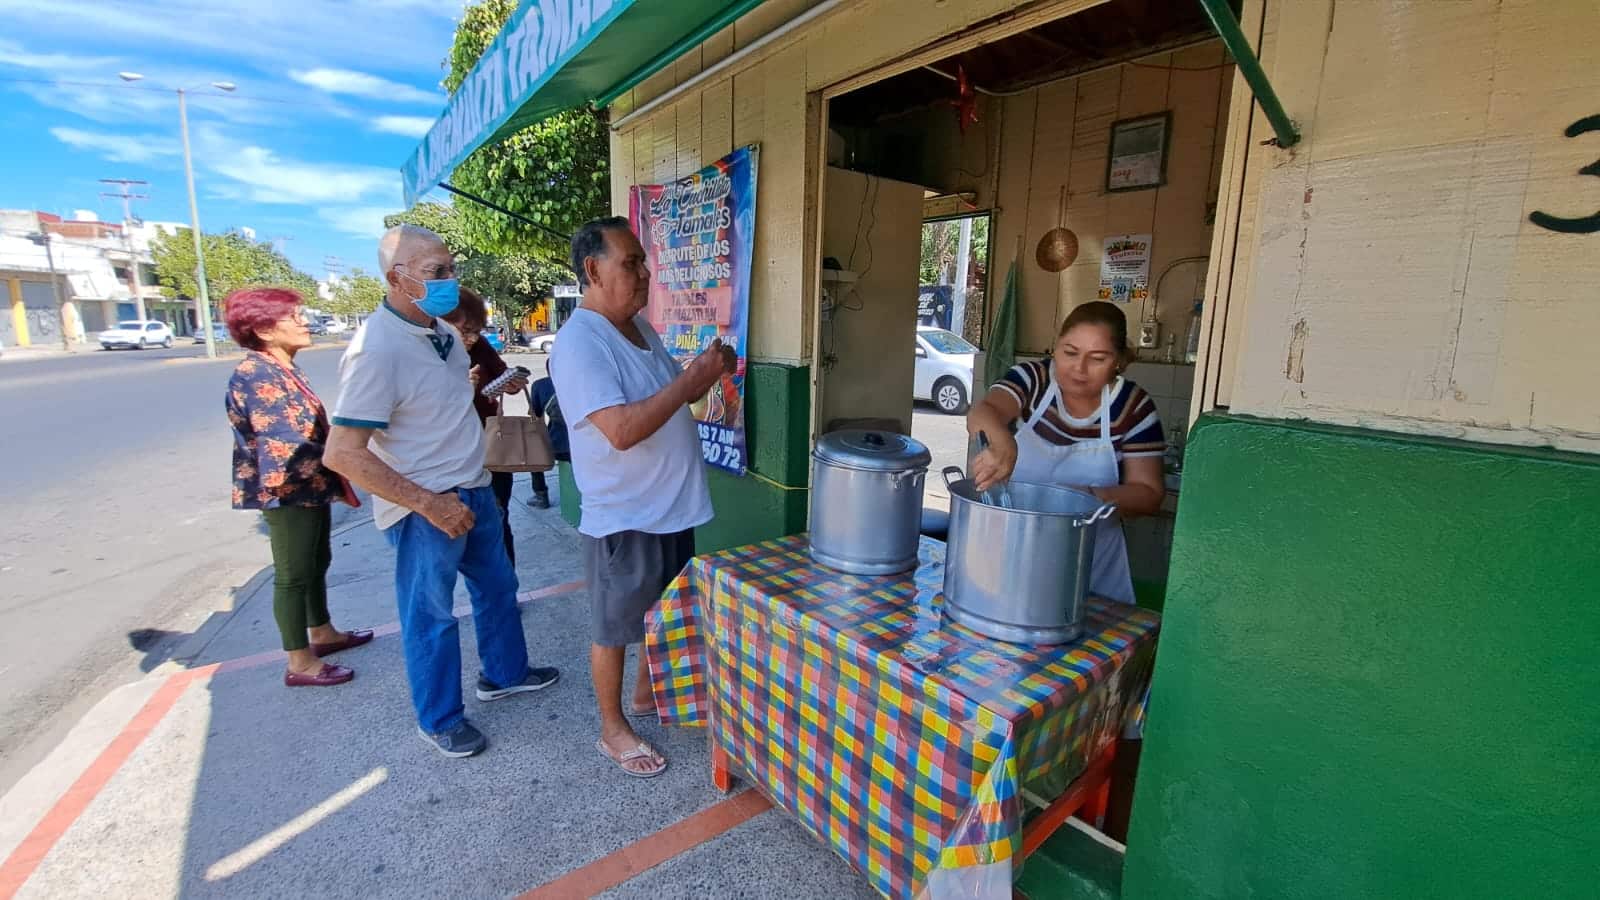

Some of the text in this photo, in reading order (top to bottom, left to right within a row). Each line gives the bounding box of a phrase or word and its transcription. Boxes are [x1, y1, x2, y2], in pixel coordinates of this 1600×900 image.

[506, 0, 615, 102] TAM
[709, 239, 730, 257] LOS
[675, 262, 731, 281] DELICIOSOS
[1112, 285, 1127, 295] 30
[710, 426, 718, 441] 7
[702, 440, 740, 469] 50 72
